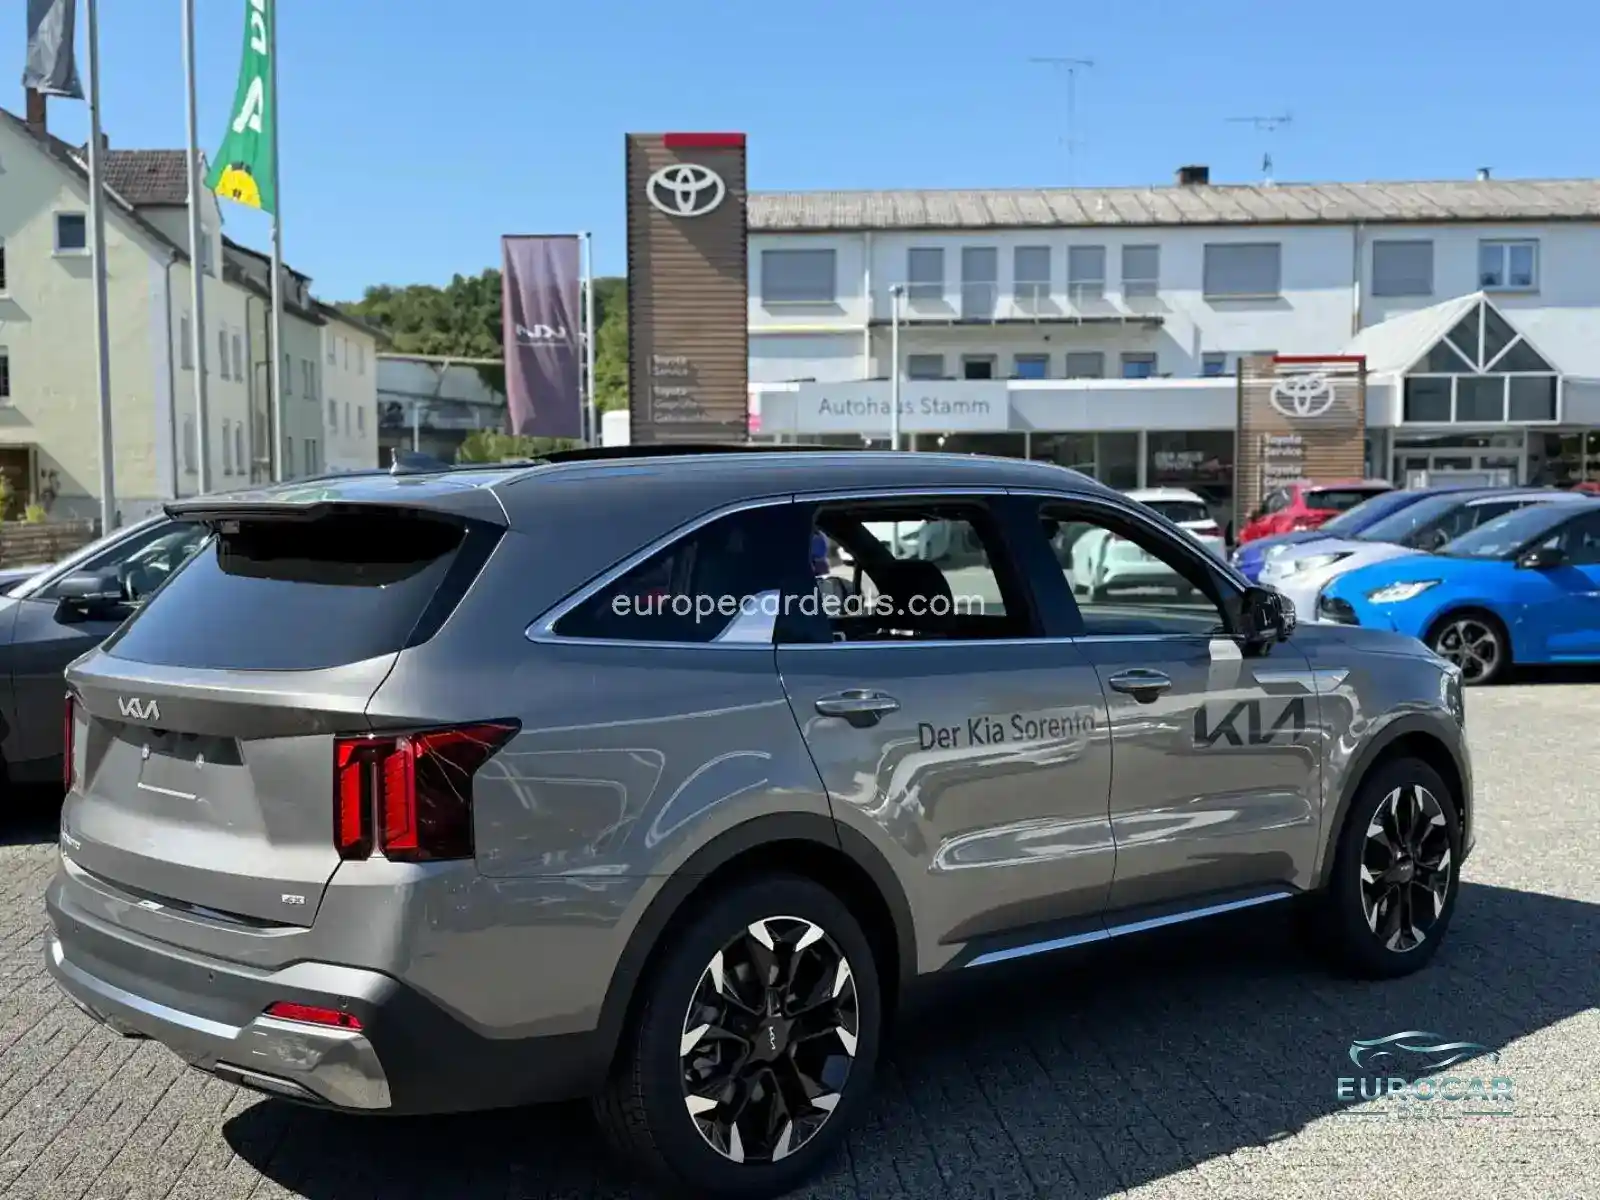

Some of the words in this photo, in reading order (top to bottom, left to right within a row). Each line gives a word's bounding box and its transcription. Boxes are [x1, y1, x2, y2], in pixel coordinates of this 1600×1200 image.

[920, 396, 990, 415] Stamm
[118, 696, 160, 720] KIA
[1194, 696, 1306, 746] KIA
[918, 722, 961, 750] Der
[967, 717, 1005, 746] Kia
[1010, 711, 1095, 741] Sorento
